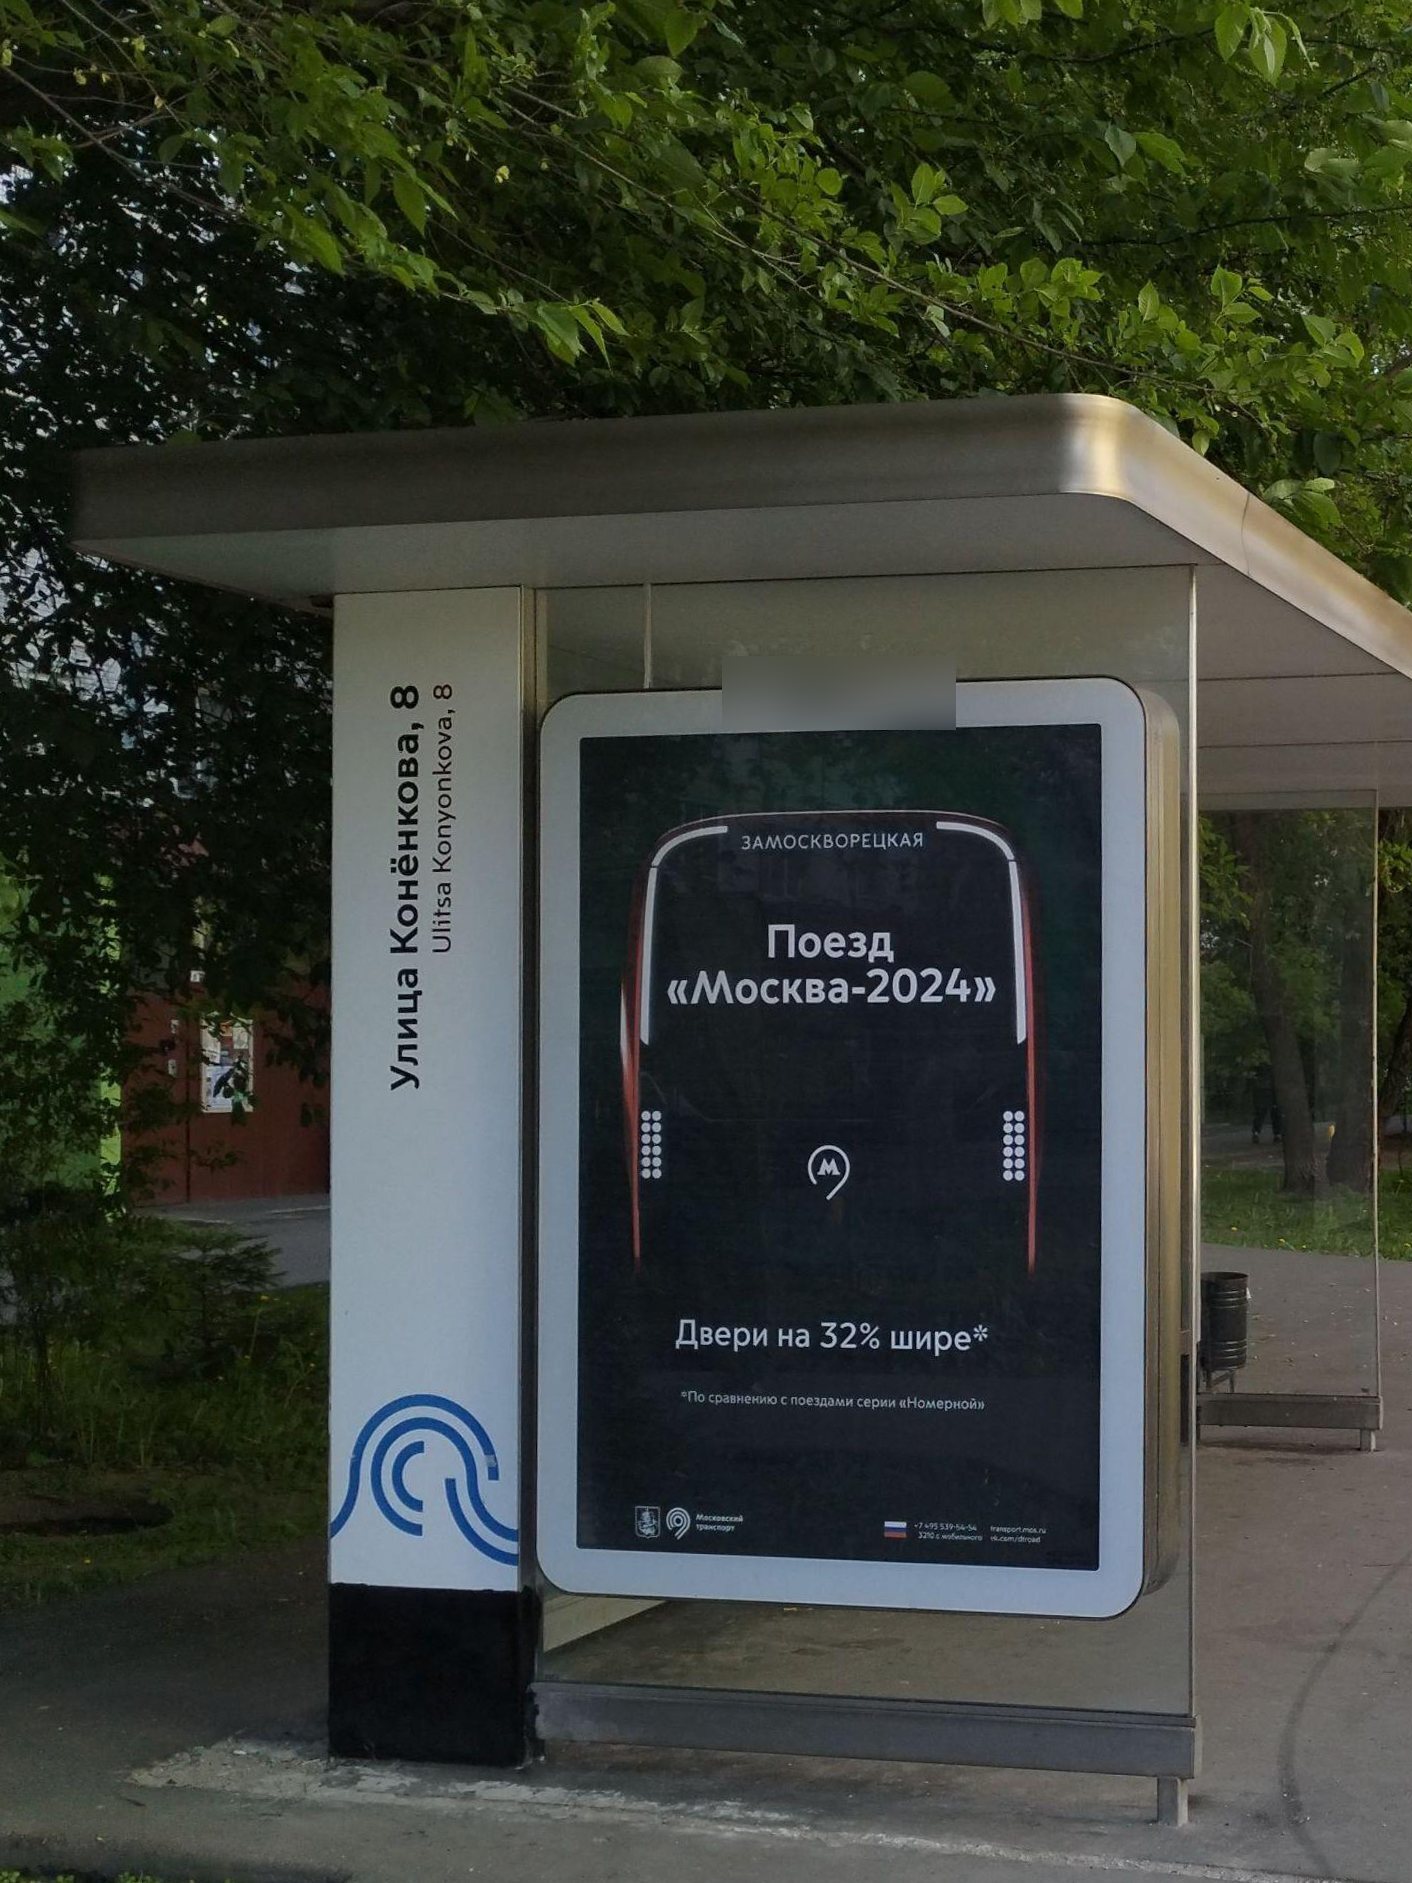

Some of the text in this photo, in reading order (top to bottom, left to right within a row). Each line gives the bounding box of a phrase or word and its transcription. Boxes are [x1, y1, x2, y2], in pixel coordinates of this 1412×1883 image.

[432, 684, 457, 953] Ulitsa Konyonkova, 8
[740, 832, 924, 851] ЗАМОСКВОРЕЦКАЯ
[390, 685, 425, 1091] Улица Конёнкова, 8
[767, 923, 895, 965] Поезд
[667, 967, 997, 1006] «Москва-2024»
[675, 1318, 768, 1353] Двери
[778, 1328, 810, 1348] на
[820, 1321, 880, 1350] 32%
[708, 1393, 778, 1406] сравнению
[780, 1396, 788, 1406] с
[790, 1396, 854, 1408] поездами
[856, 1398, 896, 1411] серии
[898, 1397, 985, 1412] «Номерной»
